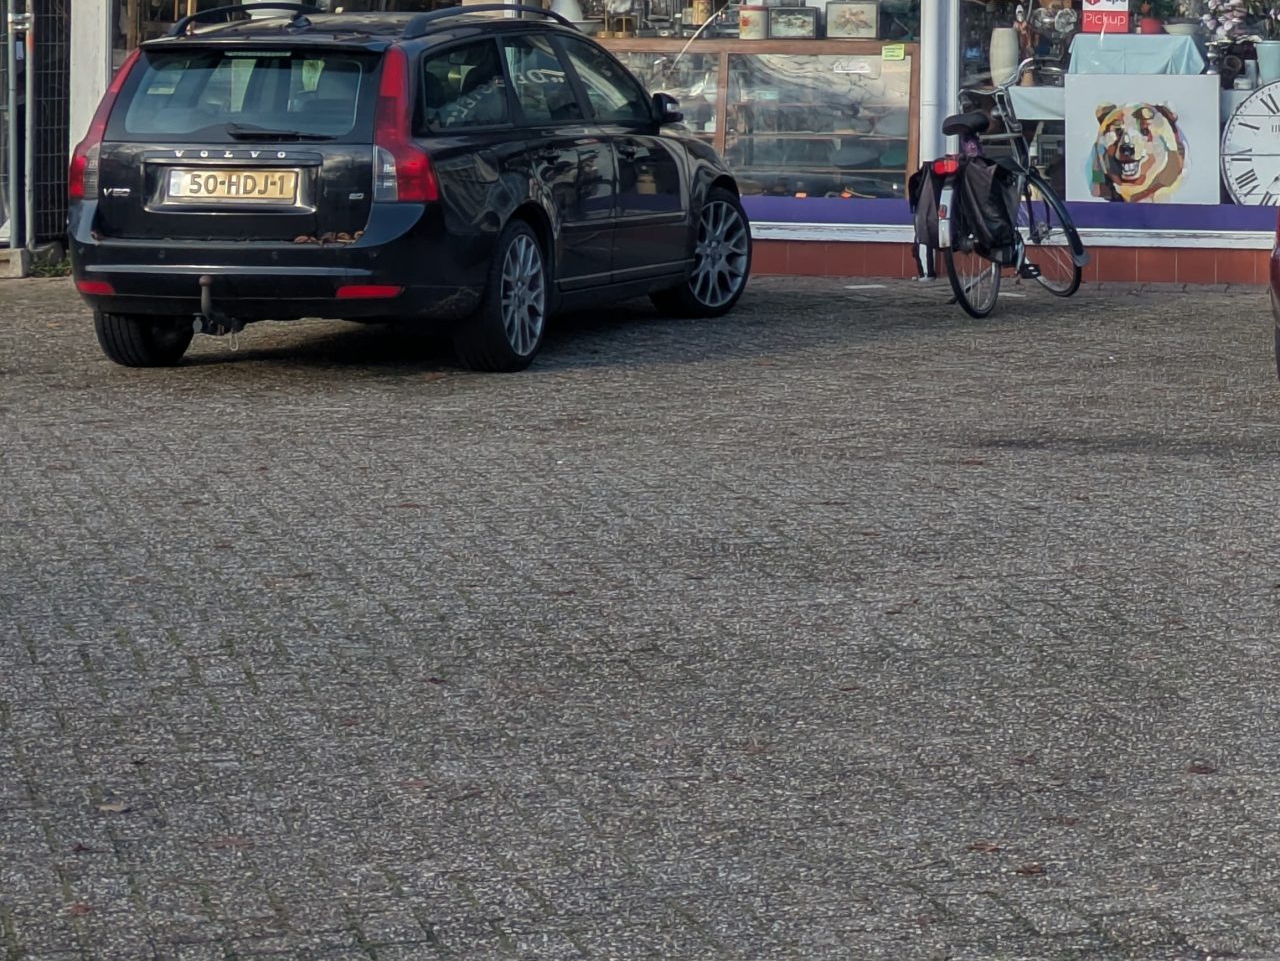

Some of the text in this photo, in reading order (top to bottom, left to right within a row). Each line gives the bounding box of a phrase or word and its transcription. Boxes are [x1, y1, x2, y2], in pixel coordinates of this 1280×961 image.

[1083, 11, 1126, 27] Pickup
[173, 150, 287, 158] VOLVO
[188, 173, 286, 196] 50-HDJ-1
